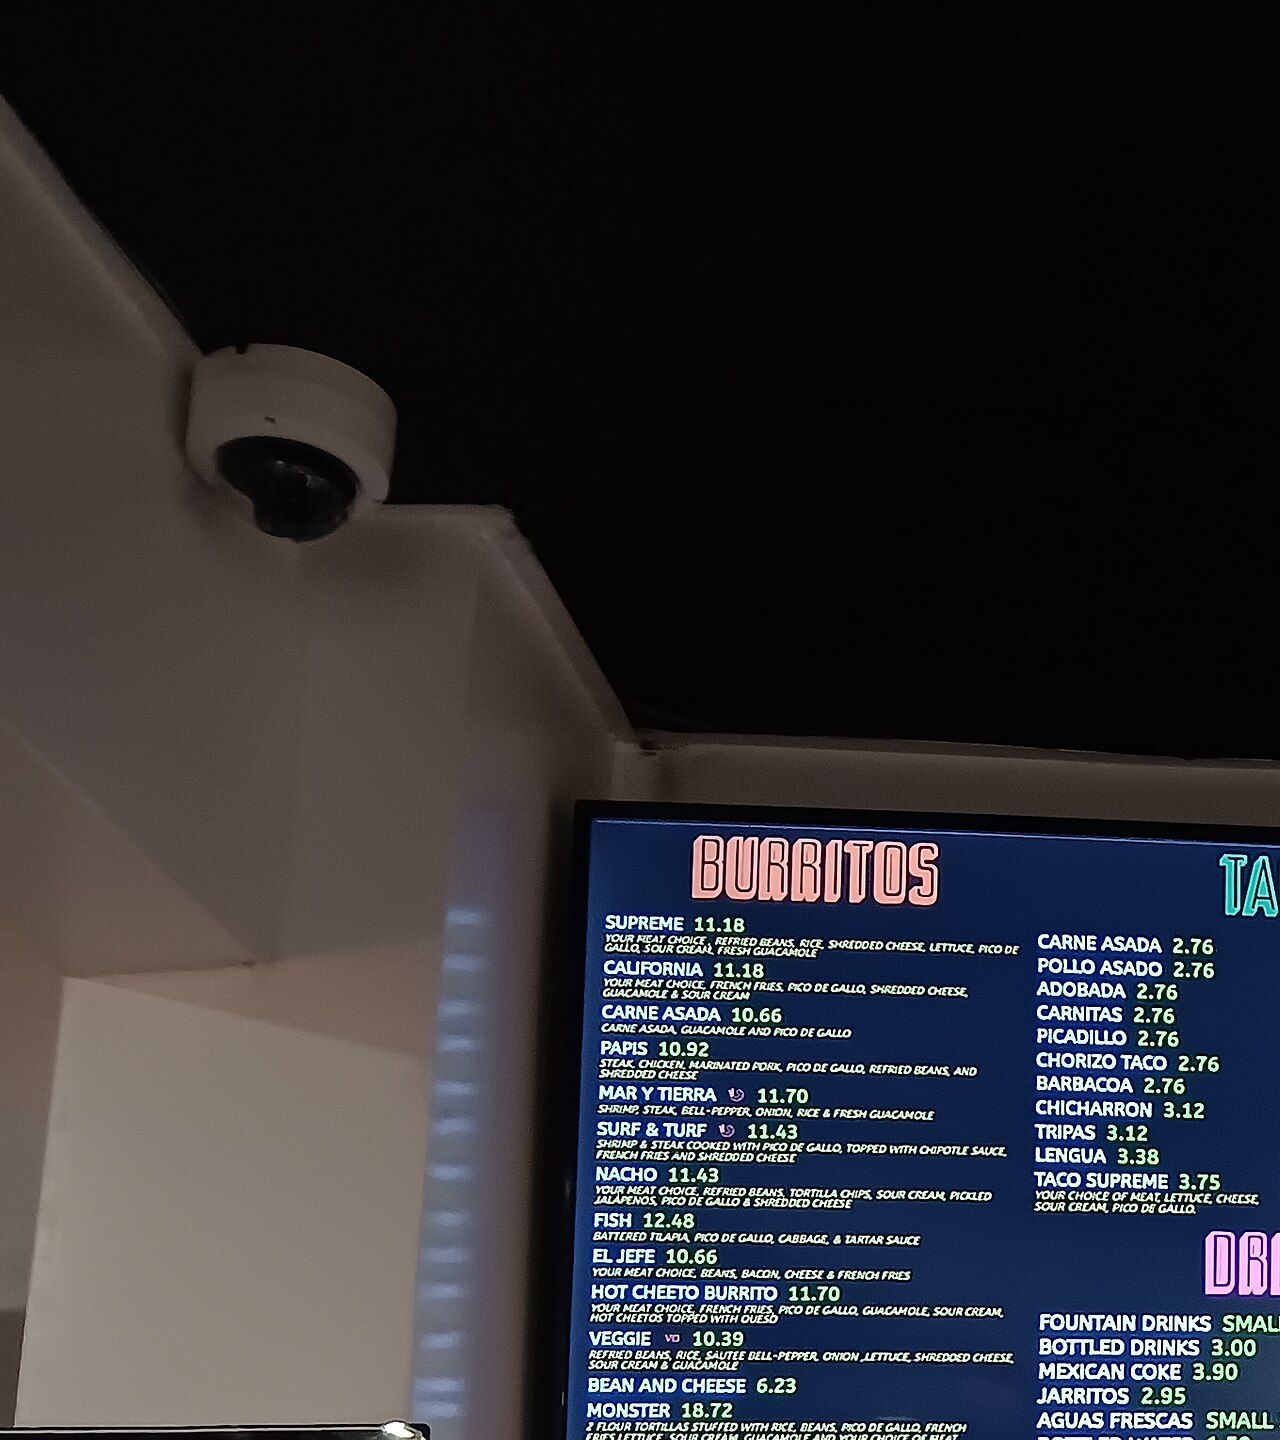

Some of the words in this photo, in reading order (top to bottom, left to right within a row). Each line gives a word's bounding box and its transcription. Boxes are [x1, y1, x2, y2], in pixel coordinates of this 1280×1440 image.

[692, 835, 938, 905] BURRITOS
[605, 915, 684, 931] SUPREME
[695, 917, 745, 932] 11.18
[1038, 934, 1097, 951] CARNE
[1101, 936, 1162, 953] ASADA
[1173, 938, 1213, 954] 2.76
[604, 960, 703, 976] CALIFORNIA
[714, 963, 764, 978] 11.18
[1038, 958, 1095, 974] POLLO
[1100, 960, 1162, 976] ASADO
[1173, 962, 1214, 978] 2.76
[1037, 981, 1126, 998] ADOBADA
[1137, 983, 1177, 1000] 2.76
[602, 1005, 659, 1020] CARNE
[662, 1006, 721, 1021] ASADA
[732, 1008, 781, 1023] 10.66
[601, 1041, 648, 1055] PAPIS
[659, 1042, 709, 1057] 10.92
[1036, 1100, 1152, 1117] CHICHARRON
[1164, 1102, 1204, 1118] 3.12
[591, 1284, 628, 1299] HOT
[632, 1285, 699, 1300] CHEETO
[704, 1286, 777, 1301] BURRITO
[789, 1286, 840, 1301] 11.70
[1040, 1314, 1136, 1331] FOUNTAIN
[1142, 1315, 1211, 1332] DRINKS
